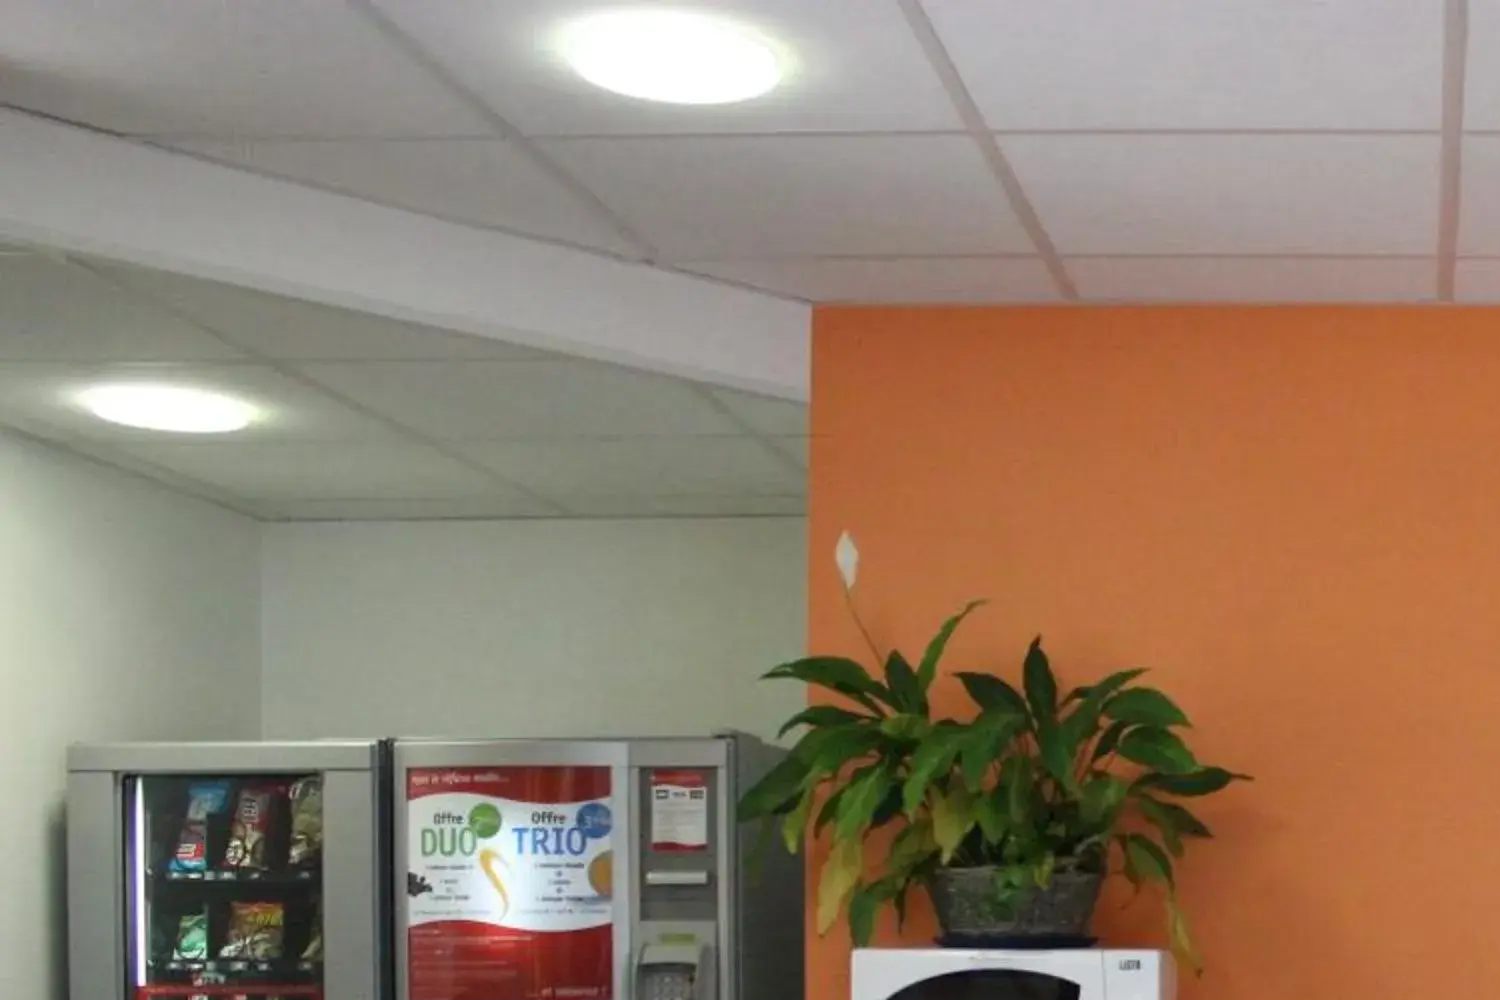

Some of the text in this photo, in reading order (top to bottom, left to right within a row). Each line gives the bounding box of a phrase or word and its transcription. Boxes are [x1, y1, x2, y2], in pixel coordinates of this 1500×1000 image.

[433, 812, 464, 825] Offre
[531, 811, 566, 825] Offre
[421, 828, 477, 857] DUO
[512, 827, 587, 856] TRIO
